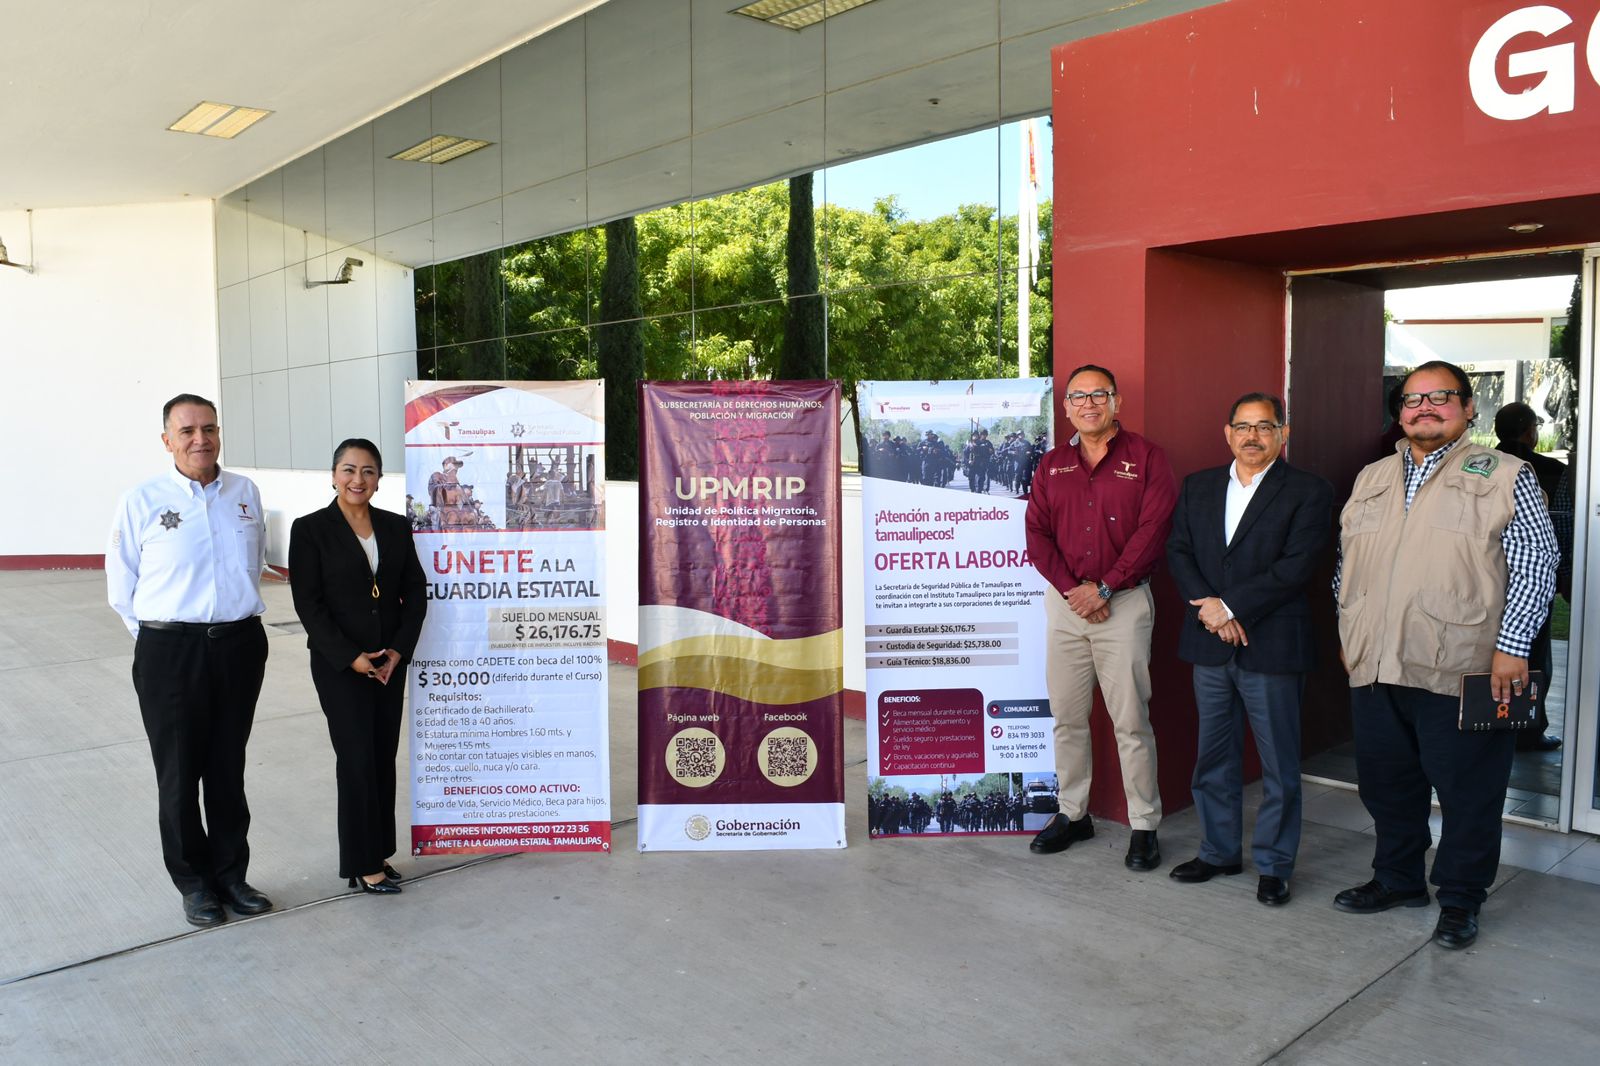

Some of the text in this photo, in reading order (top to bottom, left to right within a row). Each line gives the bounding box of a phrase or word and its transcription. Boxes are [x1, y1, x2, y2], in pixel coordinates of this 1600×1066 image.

[660, 400, 720, 409] SUBSECRETARÍA
[736, 401, 777, 409] DERECHOS
[690, 411, 736, 419] POBLACIÓN
[746, 411, 793, 419] MIGRACIÓN
[675, 476, 805, 500] UPMRIP
[665, 506, 817, 517] Unidad de Política Migratoria,
[875, 507, 1008, 526] ¡Atención a repatriados
[656, 518, 698, 527] Registro
[711, 518, 760, 526] Identidad
[763, 518, 776, 526] de
[779, 518, 826, 526] Personas
[875, 526, 954, 544] tamaulipecos!
[433, 545, 575, 574] ÚNETE A LA
[875, 551, 950, 571] OFERTA
[518, 581, 600, 598] ESTATAL
[922, 582, 949, 591] Seguridad
[981, 581, 1013, 589] Tamaulipas
[956, 591, 991, 599] Tamaulipeco
[1016, 589, 1044, 598] migrantes
[909, 601, 937, 610] integrarte
[954, 600, 992, 608] corporaciones
[1002, 599, 1032, 607] seguridad.
[502, 611, 601, 622] SUELDO MENSUAL
[516, 625, 600, 641] $ 26,176.75
[886, 625, 975, 634] Guardia Estatal: $26,176.75
[886, 642, 916, 650] Custodia
[927, 640, 962, 651] Seguridad:
[964, 640, 1001, 650] $25,738.00
[412, 659, 446, 669] Ingresa
[477, 658, 515, 666] CADETE
[561, 656, 574, 664] del
[577, 656, 602, 664] 100%
[904, 657, 930, 665] Técnico:
[932, 656, 970, 666] $18,836.00
[418, 671, 602, 688] $ 30,000 (diferido durante el Curso)
[429, 693, 481, 703] Requisitos:
[425, 707, 469, 715] Certificado
[484, 706, 534, 714] Bachillerato.
[425, 718, 445, 726] Edad
[460, 718, 470, 726] 18
[479, 717, 491, 725] 40
[494, 717, 515, 725] años.
[667, 713, 719, 724] Página web
[764, 713, 807, 721] Facebook
[460, 729, 489, 738] mínima
[491, 728, 528, 737] Hombres
[425, 742, 456, 751] Mujeres
[440, 752, 466, 760] contar
[486, 751, 519, 760] tatuajes
[522, 749, 551, 758] visibles
[567, 750, 596, 758] manos,
[425, 764, 452, 773] dedos,
[455, 763, 481, 771] cuello,
[505, 762, 519, 771] y/o
[425, 775, 448, 783] Entre
[444, 784, 580, 795] BENEFICIOS COMO ACTIVO:
[416, 797, 607, 809] Seguro de Vida, Servicio Médico, Beca para hijos,
[463, 809, 560, 819] entre otras prestaciones.
[436, 825, 589, 835] MAYORES INFORMES: 800 122 23 36
[716, 819, 800, 831] Gobernación
[436, 839, 462, 848] ÚNETE
[463, 839, 470, 847] A
[483, 838, 518, 847] GUARDIA
[521, 837, 551, 845] ESTATAL
[553, 836, 601, 845] TAMAULIPAS
